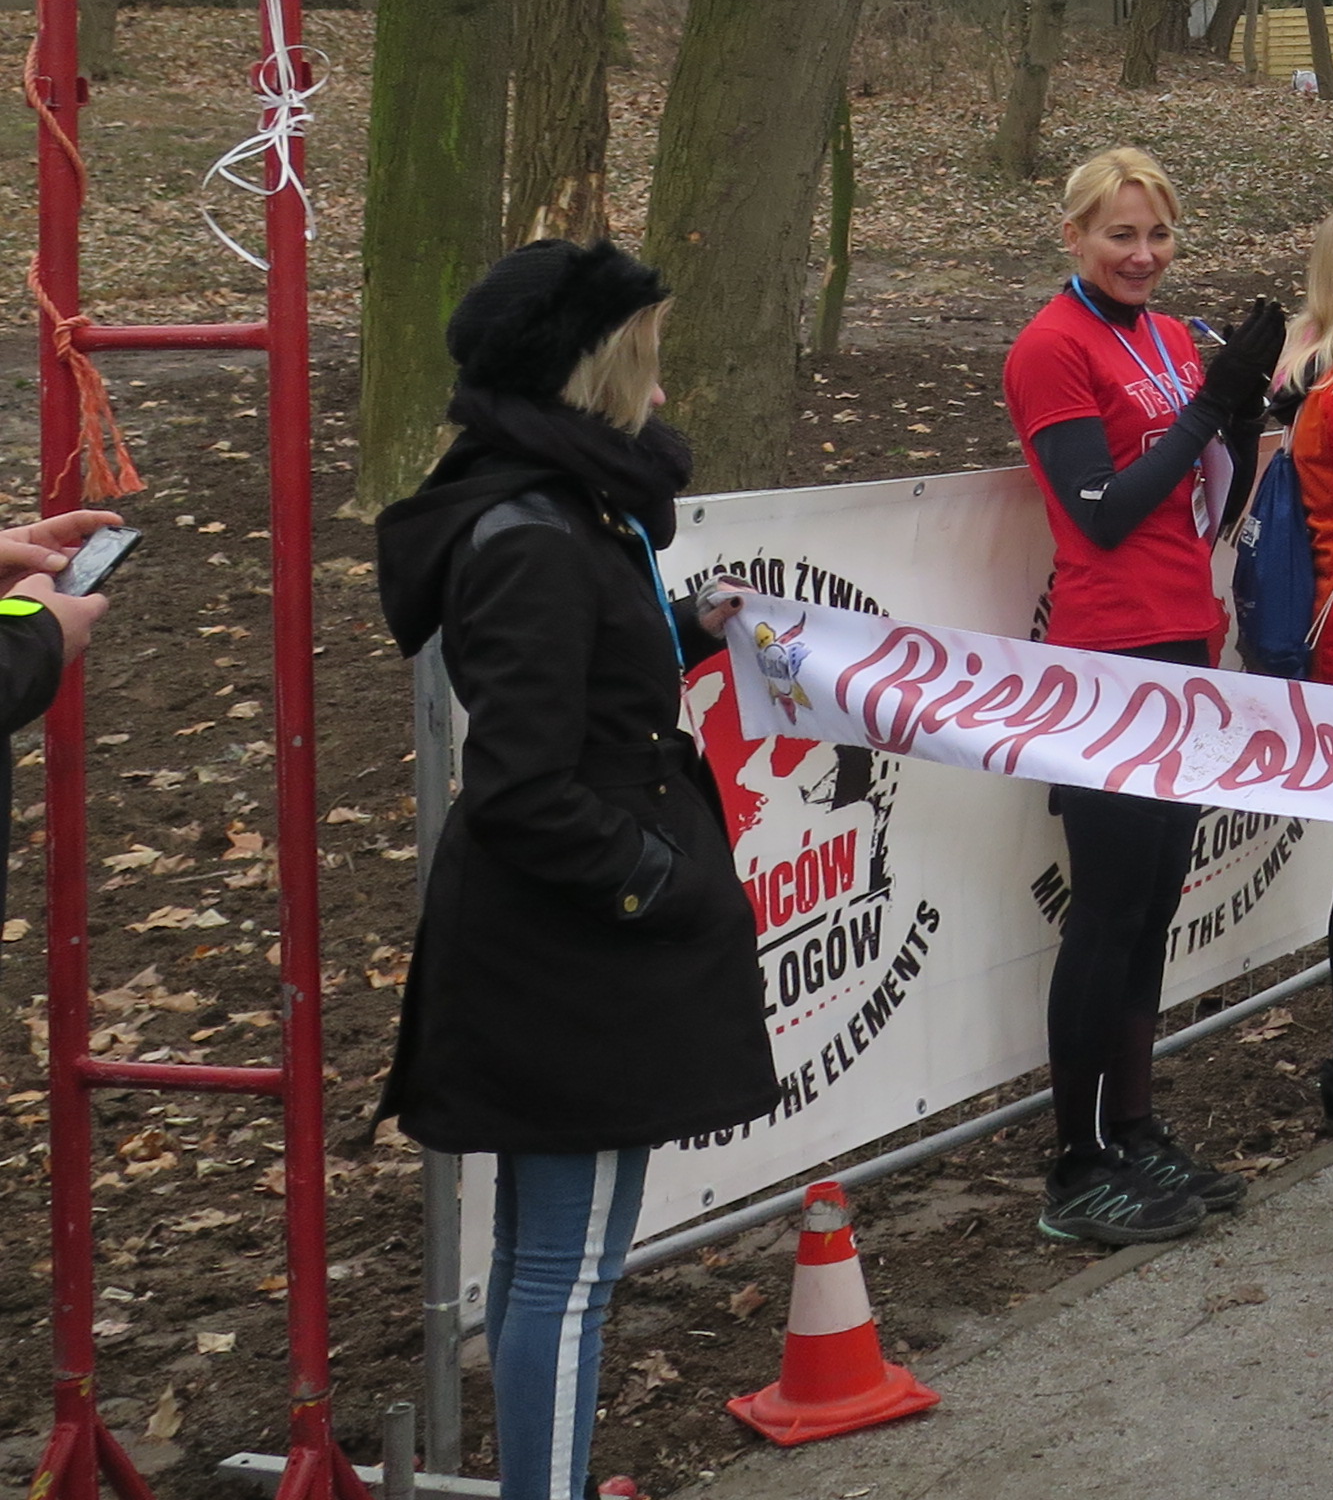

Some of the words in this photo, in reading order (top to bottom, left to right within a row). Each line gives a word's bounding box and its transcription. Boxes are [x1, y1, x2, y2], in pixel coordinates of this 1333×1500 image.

[835, 626, 1099, 775] Bieg
[1187, 902, 1226, 955] THE
[1231, 816, 1311, 925] ELEMEN
[820, 900, 941, 1086] ELEMENTS
